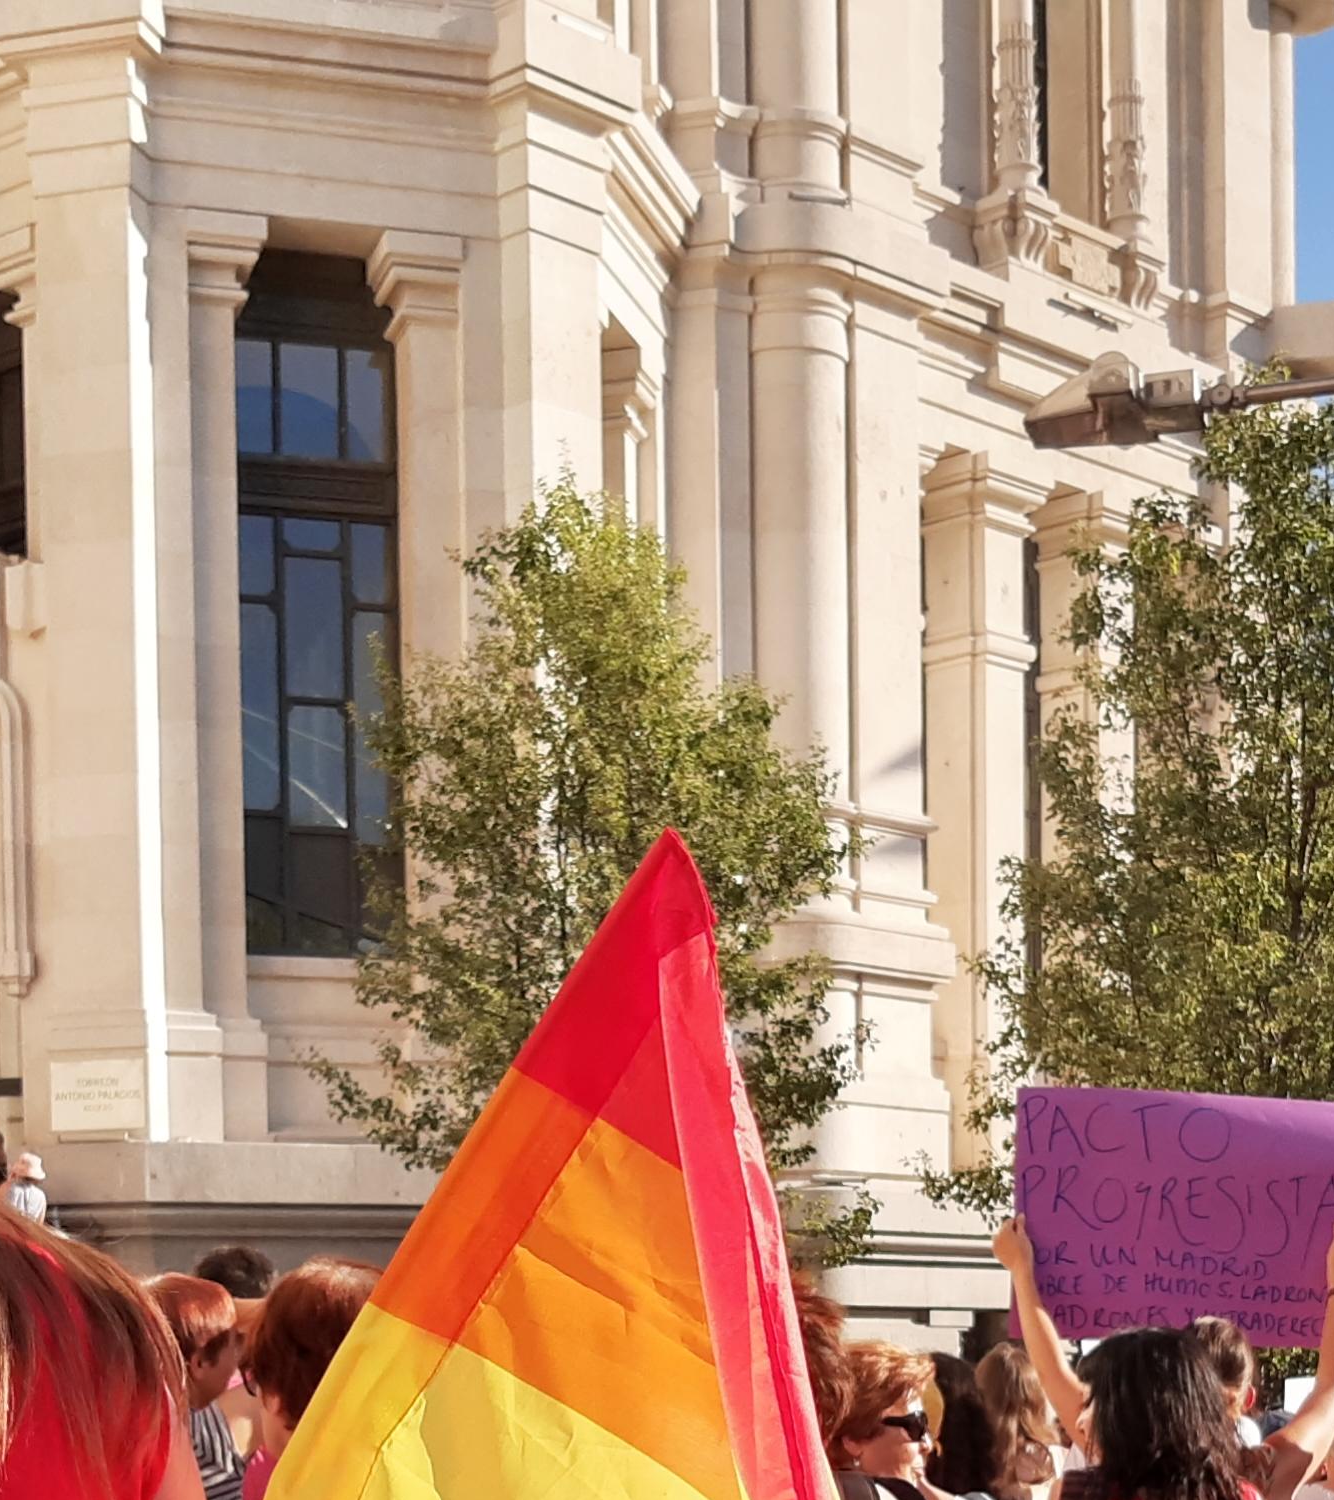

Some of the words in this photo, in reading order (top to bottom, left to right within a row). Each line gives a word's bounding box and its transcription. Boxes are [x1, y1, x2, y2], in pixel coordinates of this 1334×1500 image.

[55, 1091, 95, 1101] ANTONIO
[1022, 1095, 1231, 1163] PACTO
[1033, 1240, 1077, 1266] OR
[1090, 1243, 1136, 1268] UN
[1155, 1246, 1267, 1281] MADRID
[1104, 1273, 1128, 1294] DE
[1241, 1284, 1328, 1304] LADRON
[1053, 1304, 1171, 1330] ADRONES
